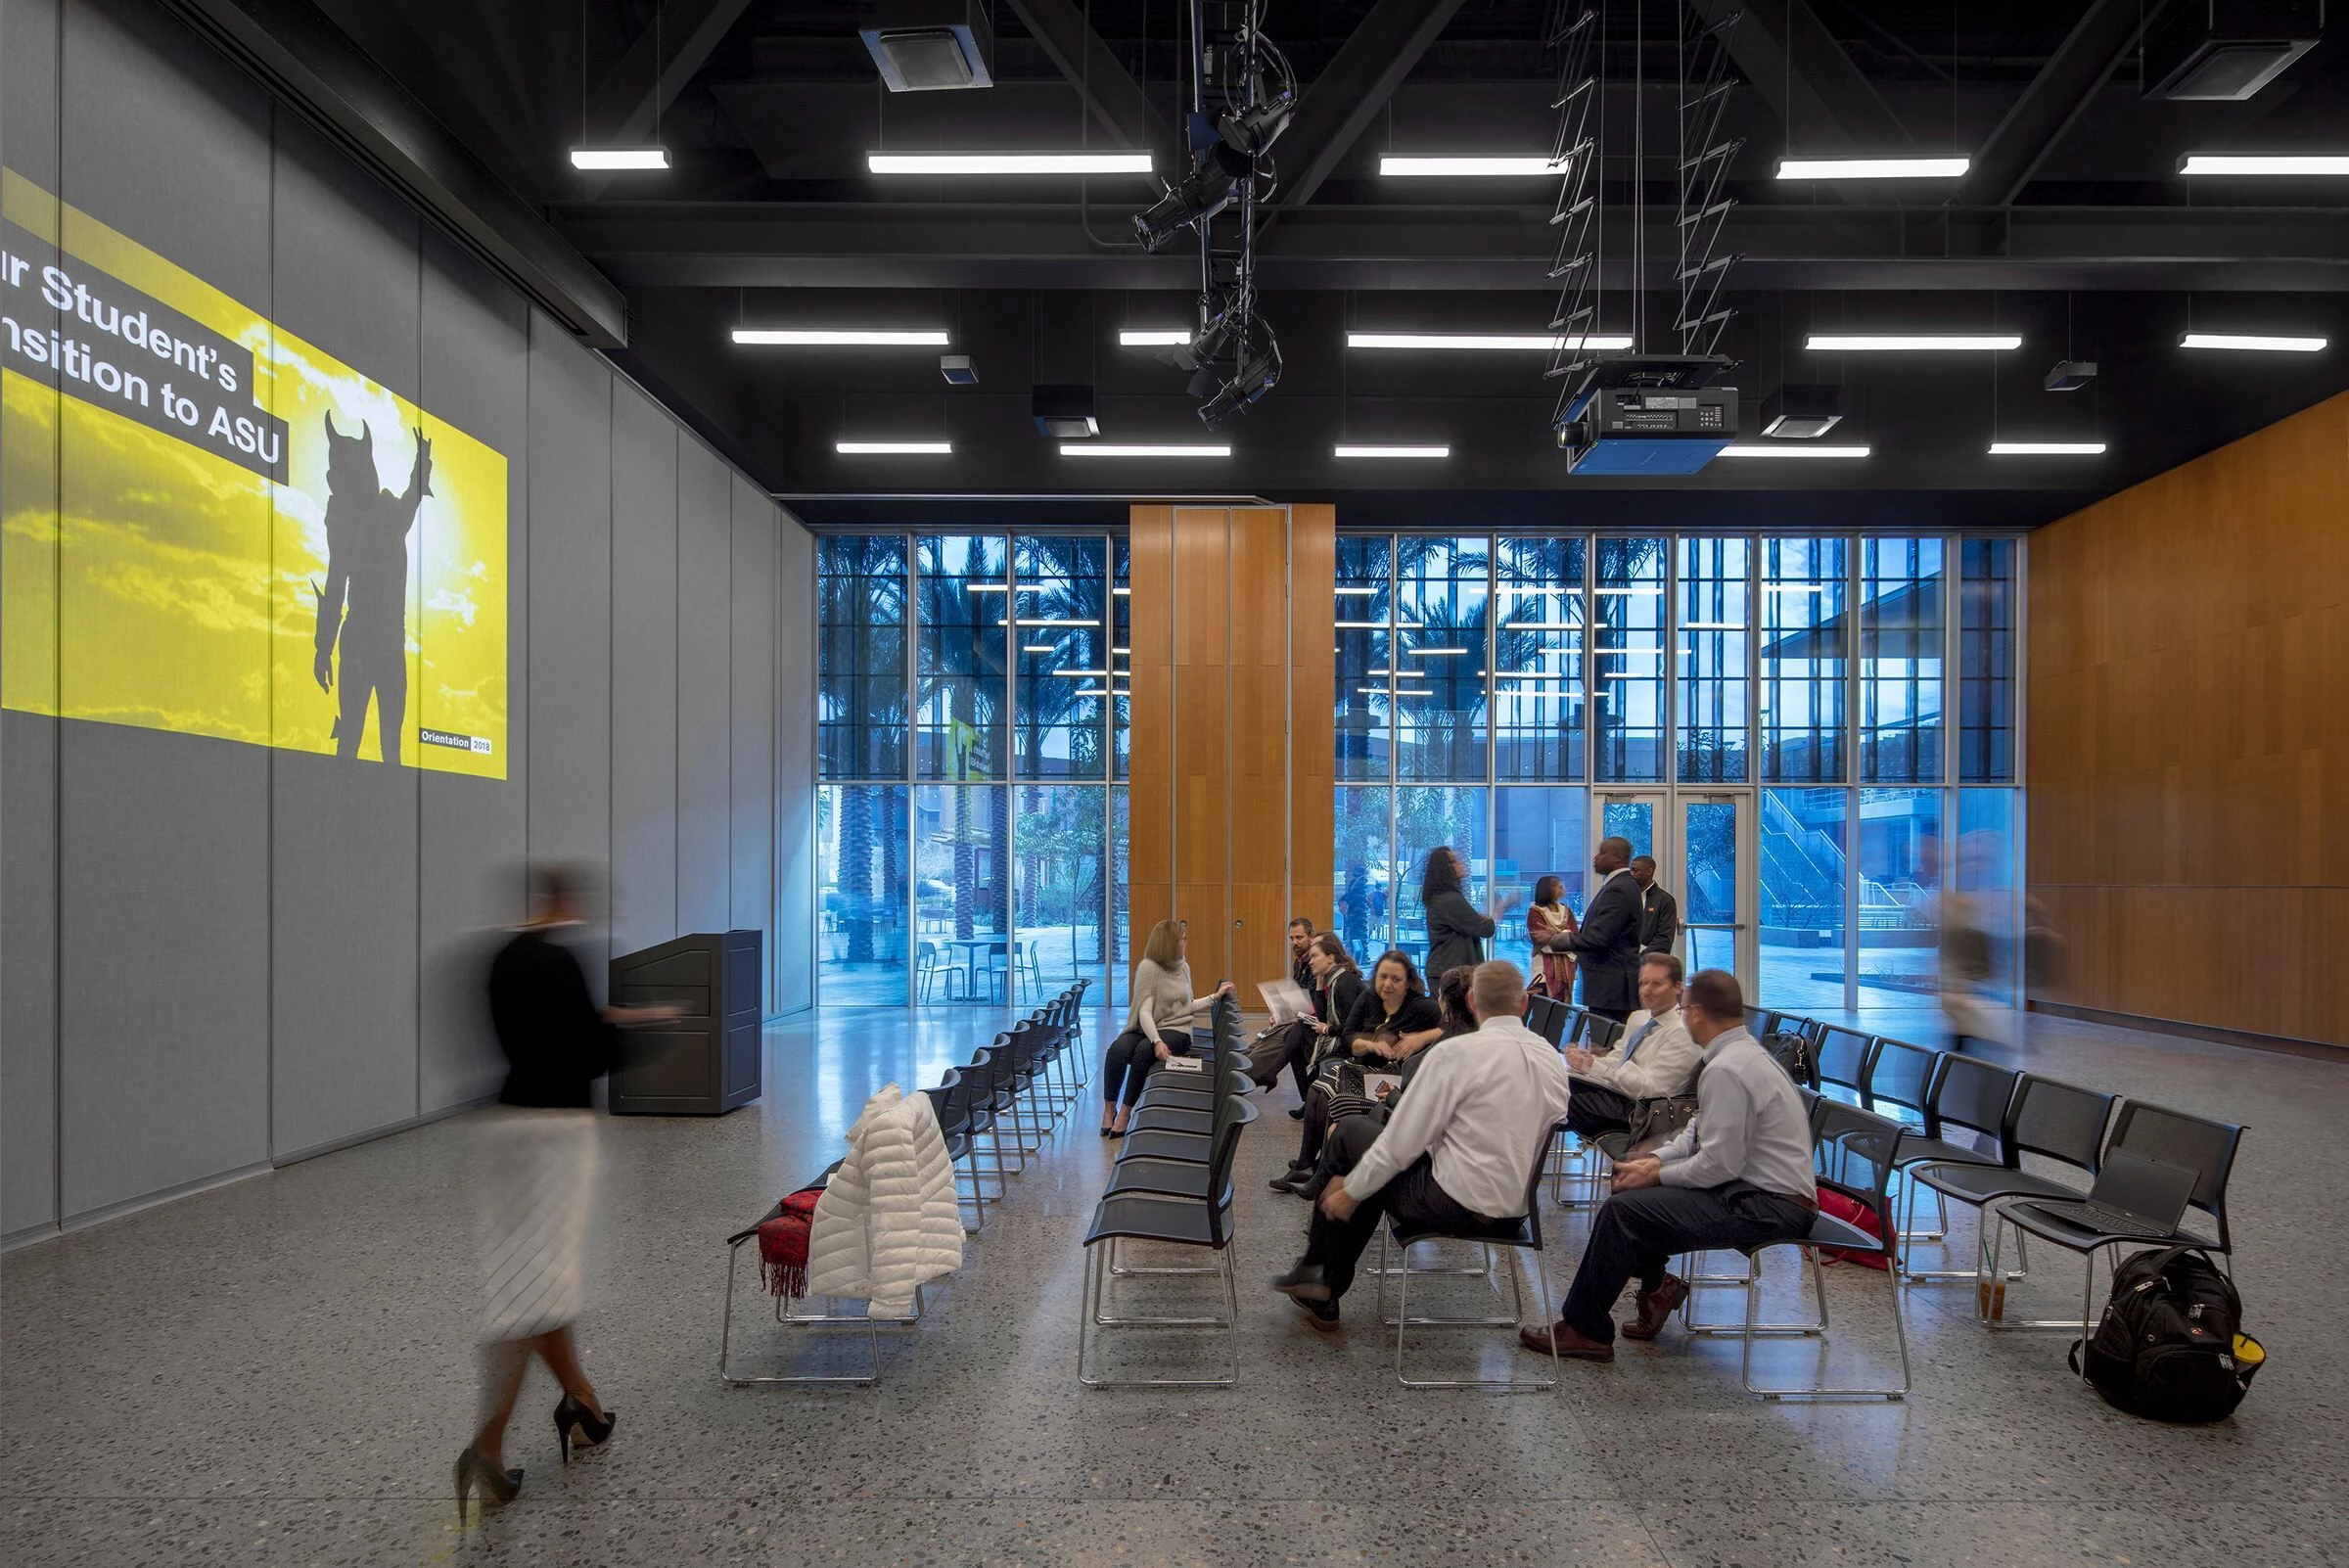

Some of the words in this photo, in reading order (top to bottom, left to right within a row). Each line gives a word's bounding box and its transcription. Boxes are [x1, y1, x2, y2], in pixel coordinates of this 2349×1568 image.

[2, 250, 30, 288] r
[41, 265, 238, 392] Student’s
[161, 383, 200, 427] to
[207, 405, 279, 464] ASU
[421, 730, 469, 748] Orientation
[474, 741, 490, 752] 2018
